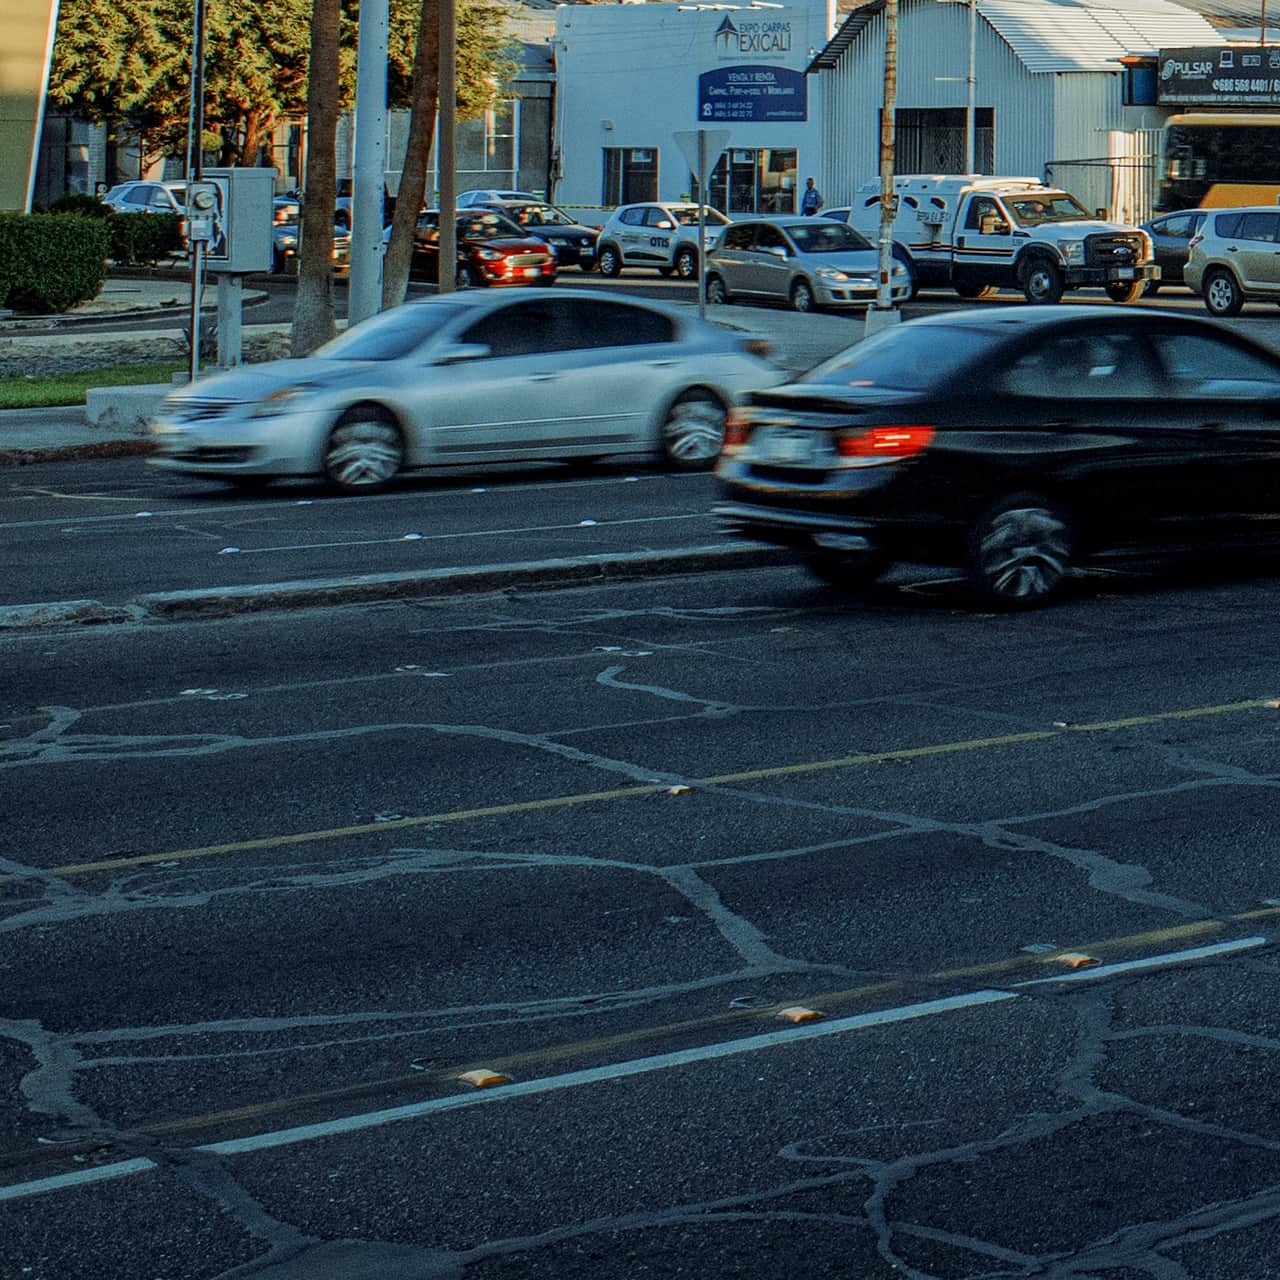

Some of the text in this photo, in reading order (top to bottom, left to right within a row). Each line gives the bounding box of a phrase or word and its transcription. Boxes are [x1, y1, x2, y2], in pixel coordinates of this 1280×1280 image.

[740, 22, 791, 32] EXPO CARPAS
[1174, 62, 1213, 74] PULSAR
[650, 237, 670, 248] OTIS
